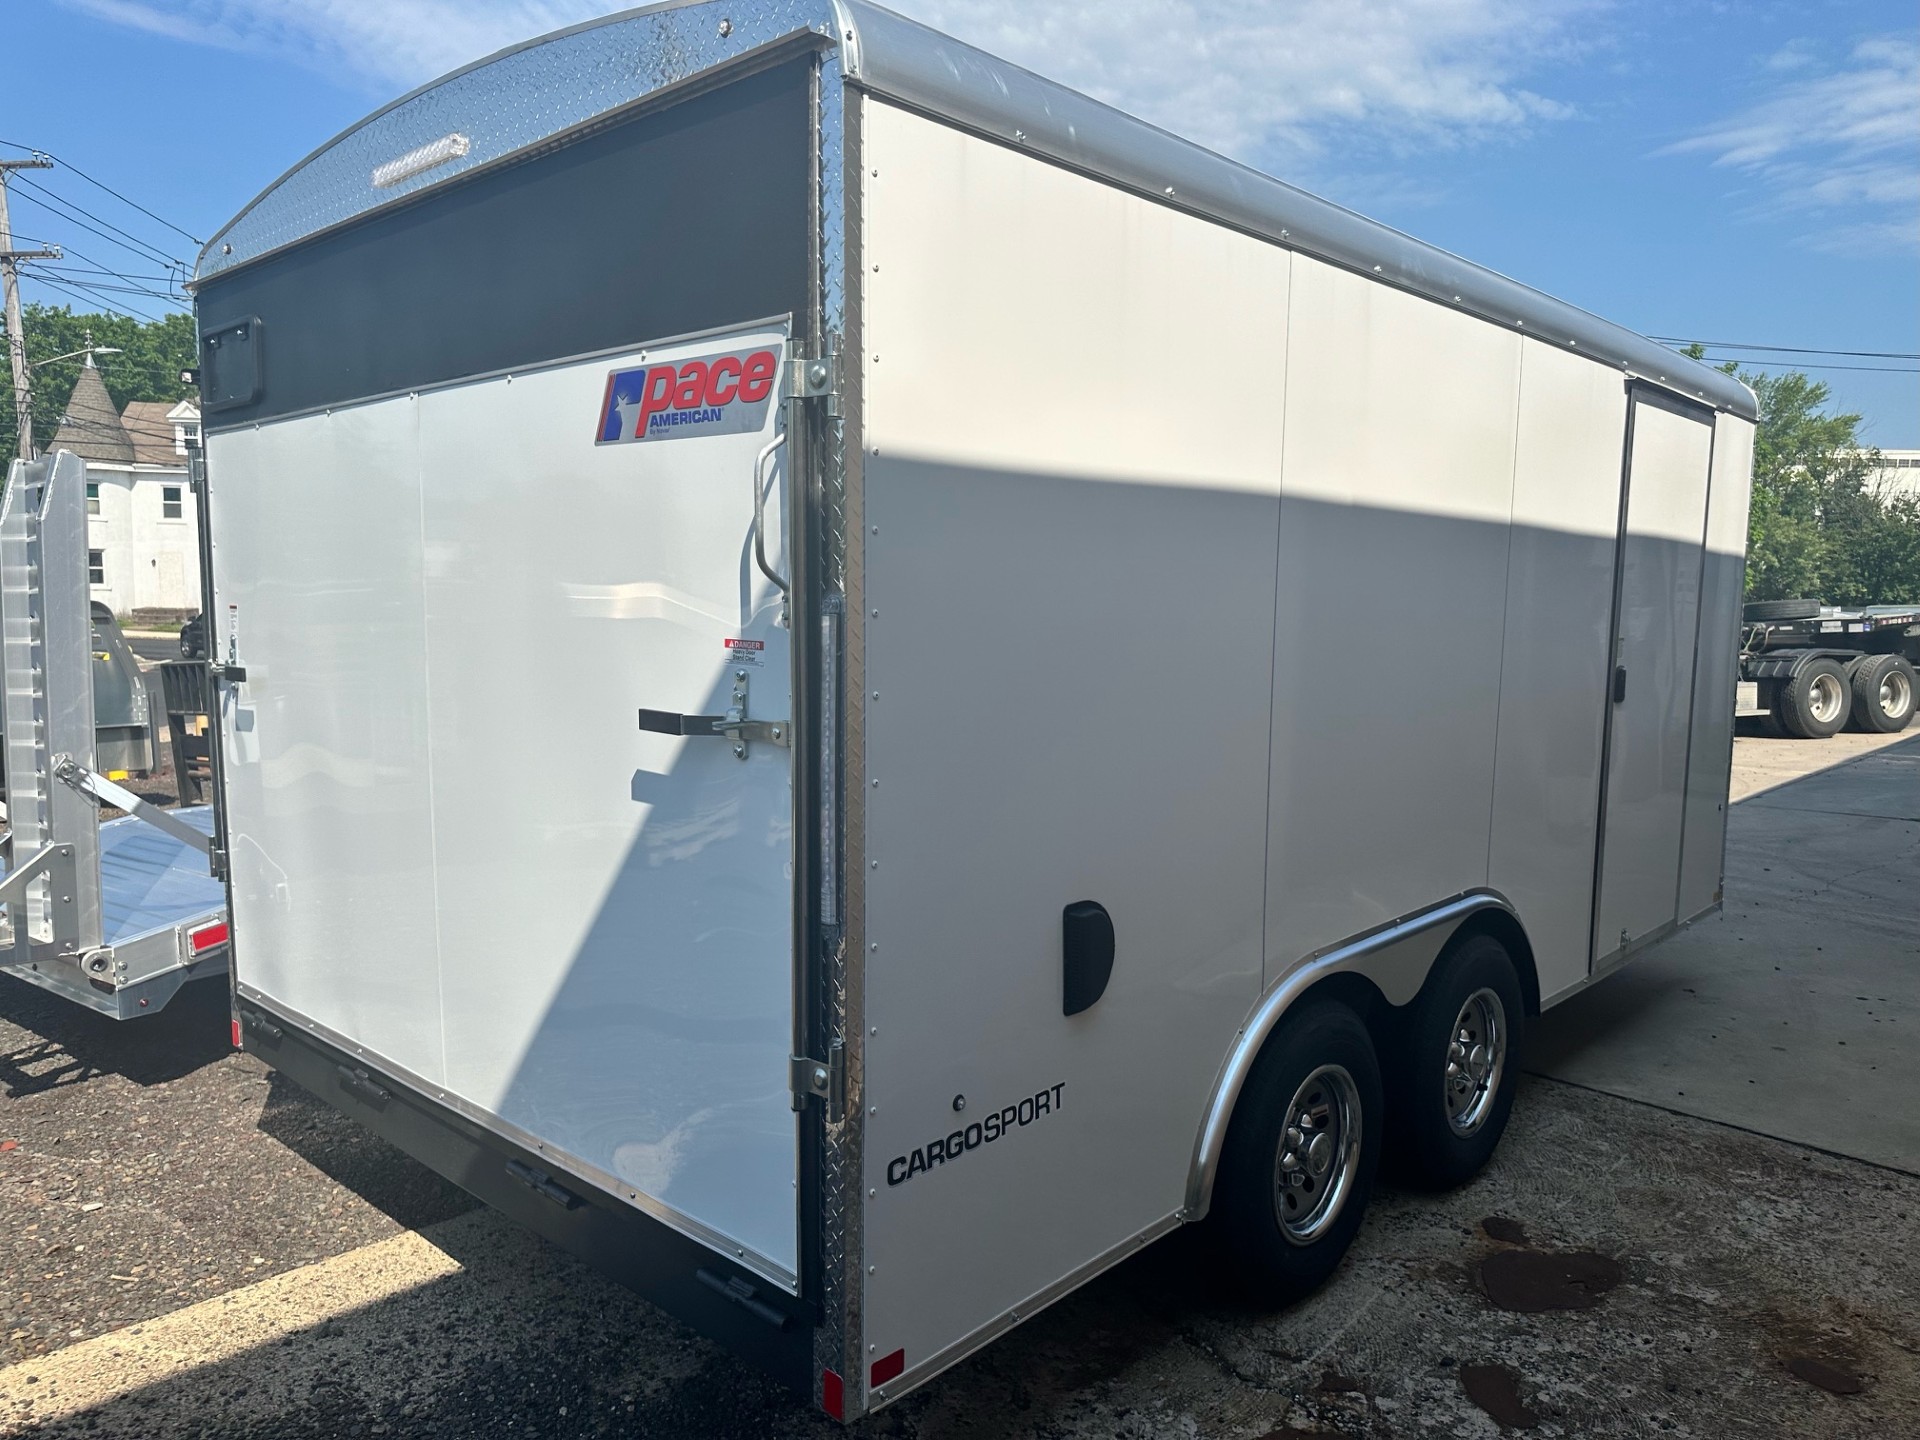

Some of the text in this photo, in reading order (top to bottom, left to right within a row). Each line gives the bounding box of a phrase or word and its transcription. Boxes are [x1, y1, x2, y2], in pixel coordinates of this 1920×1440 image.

[634, 350, 777, 438] pace
[649, 408, 722, 428] AMERICAN
[734, 641, 760, 650] DANGER
[887, 1081, 1066, 1187] CARGOSPORT
